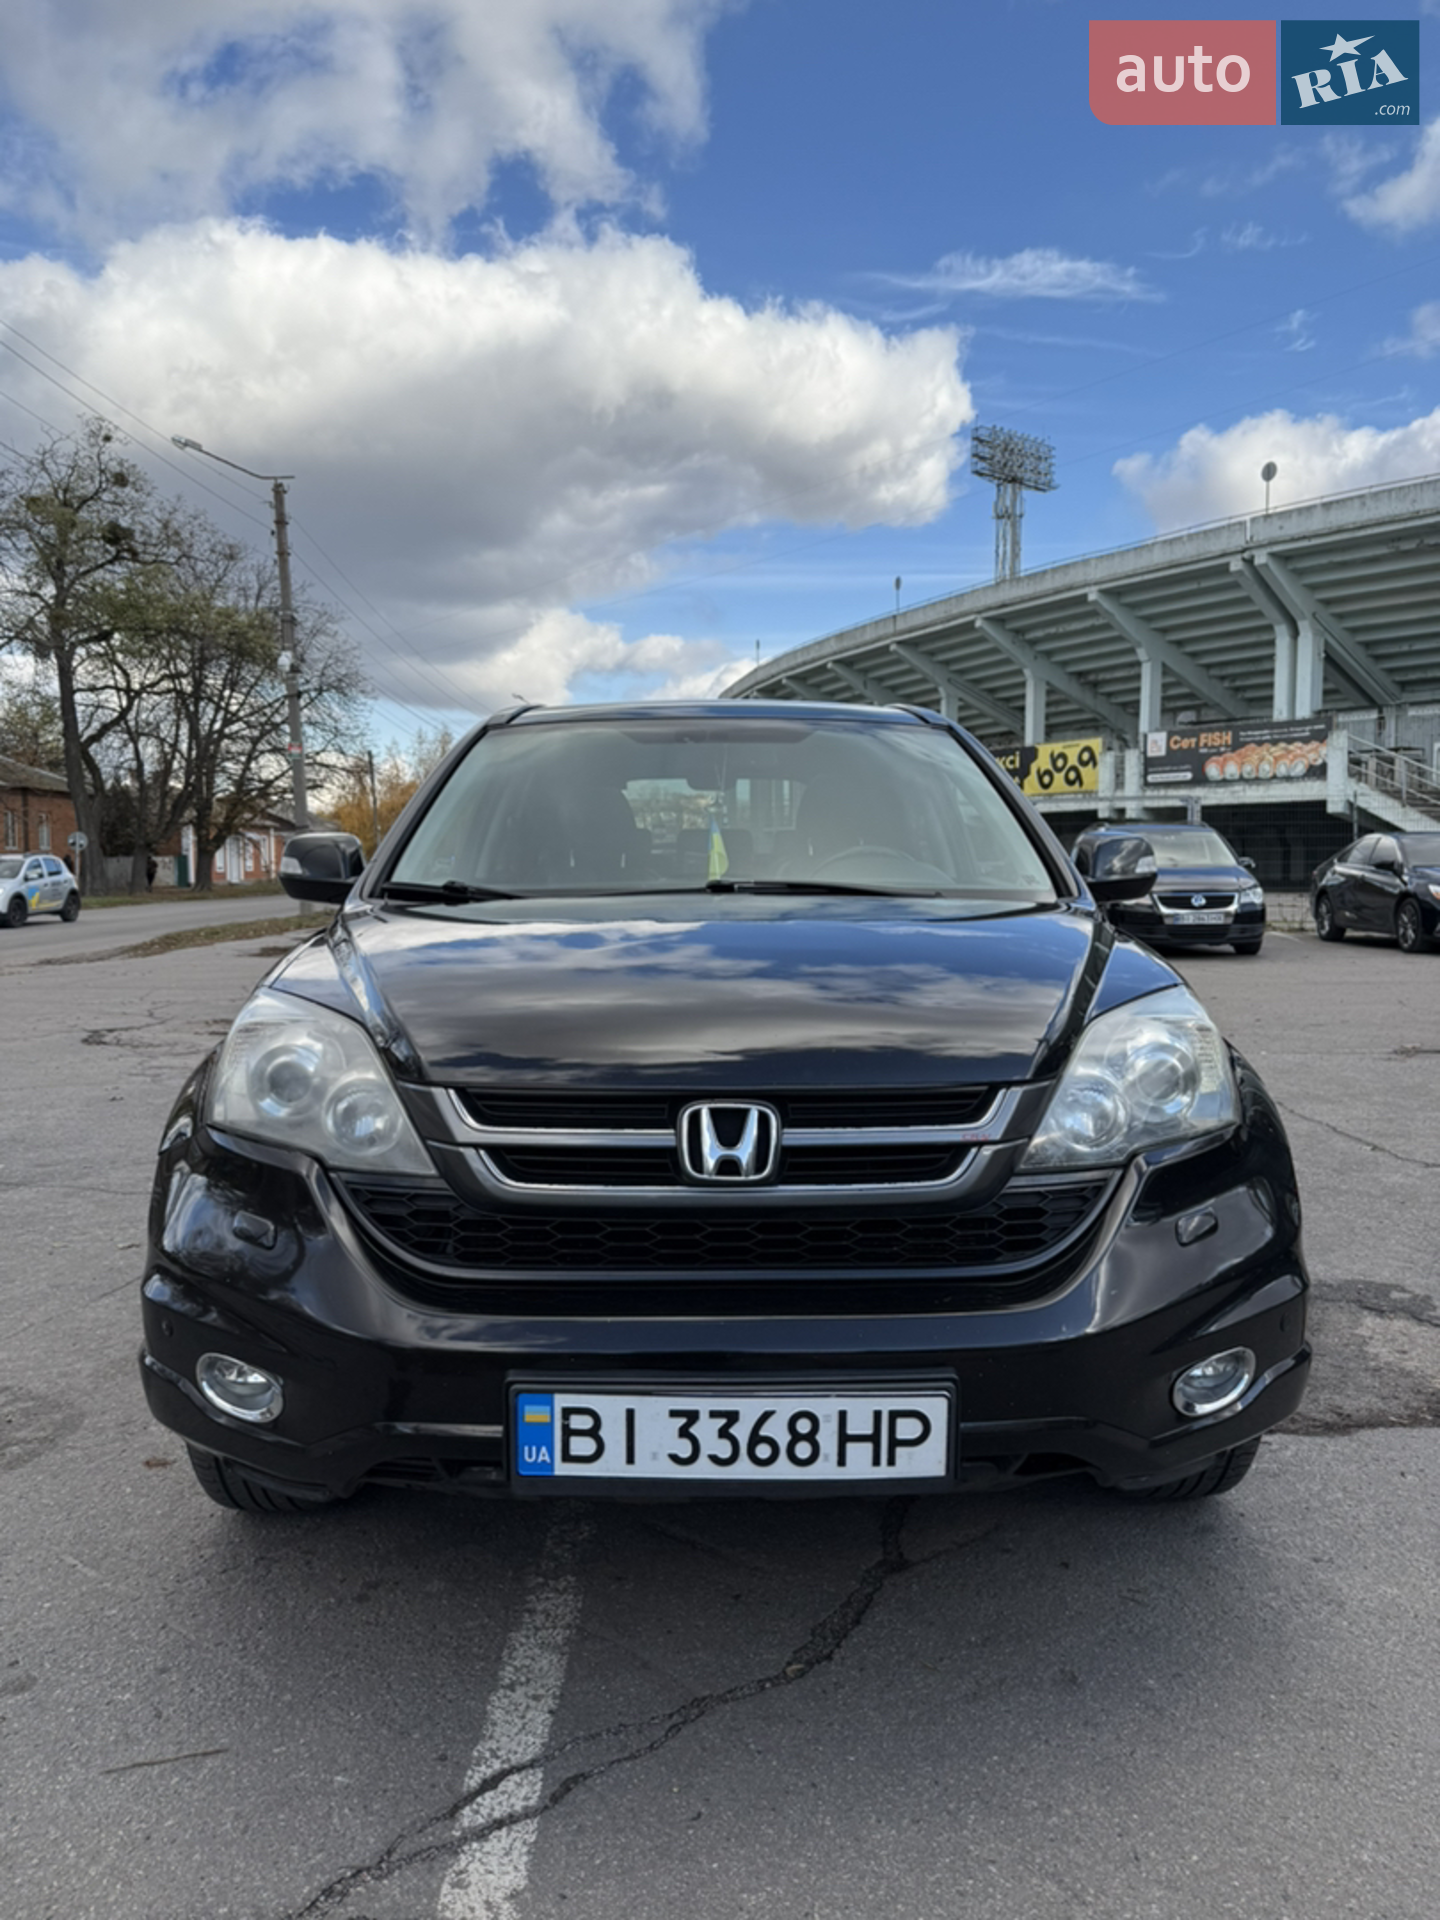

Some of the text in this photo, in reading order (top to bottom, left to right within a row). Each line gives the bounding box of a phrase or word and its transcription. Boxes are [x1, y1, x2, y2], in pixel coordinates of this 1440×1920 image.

[1199, 730, 1232, 747] FISH
[668, 1409, 821, 1468] 3368
[837, 1409, 932, 1468] HP
[524, 1445, 551, 1464] UA
